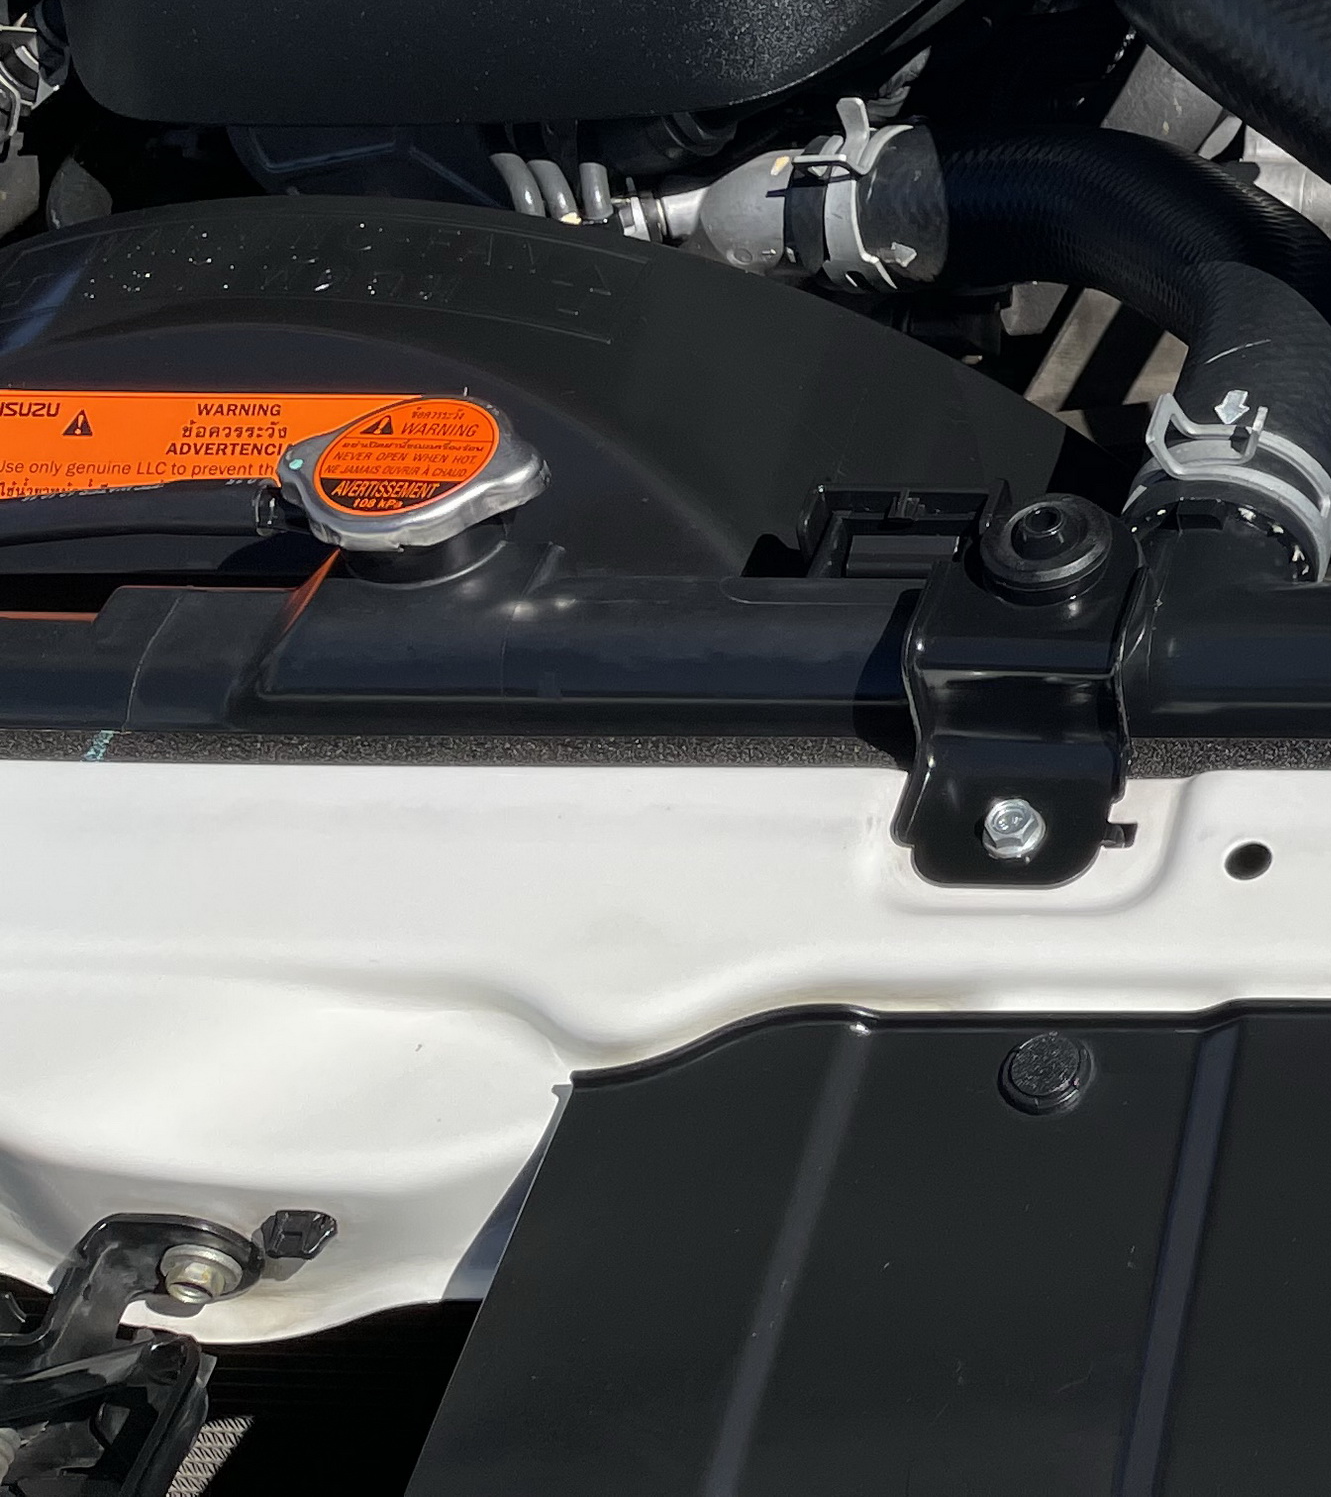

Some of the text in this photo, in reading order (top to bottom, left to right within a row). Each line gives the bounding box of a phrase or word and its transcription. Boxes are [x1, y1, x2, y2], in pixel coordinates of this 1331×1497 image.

[197, 403, 282, 416] WARNING
[401, 422, 479, 438] WARNING
[166, 442, 283, 456] ADVERTENCI
[333, 452, 375, 462] NEVER
[377, 452, 407, 462] OPEN
[412, 453, 448, 463] WHEN
[29, 460, 61, 477] only
[66, 462, 131, 476] genuine
[137, 462, 167, 475] LLC
[170, 463, 187, 475] to
[191, 463, 254, 478] prevent
[258, 463, 275, 475] th
[324, 464, 340, 474] NE
[341, 465, 381, 475] JAMAIS
[331, 480, 442, 499] AVERTISSEMENT
[353, 498, 374, 508] 108
